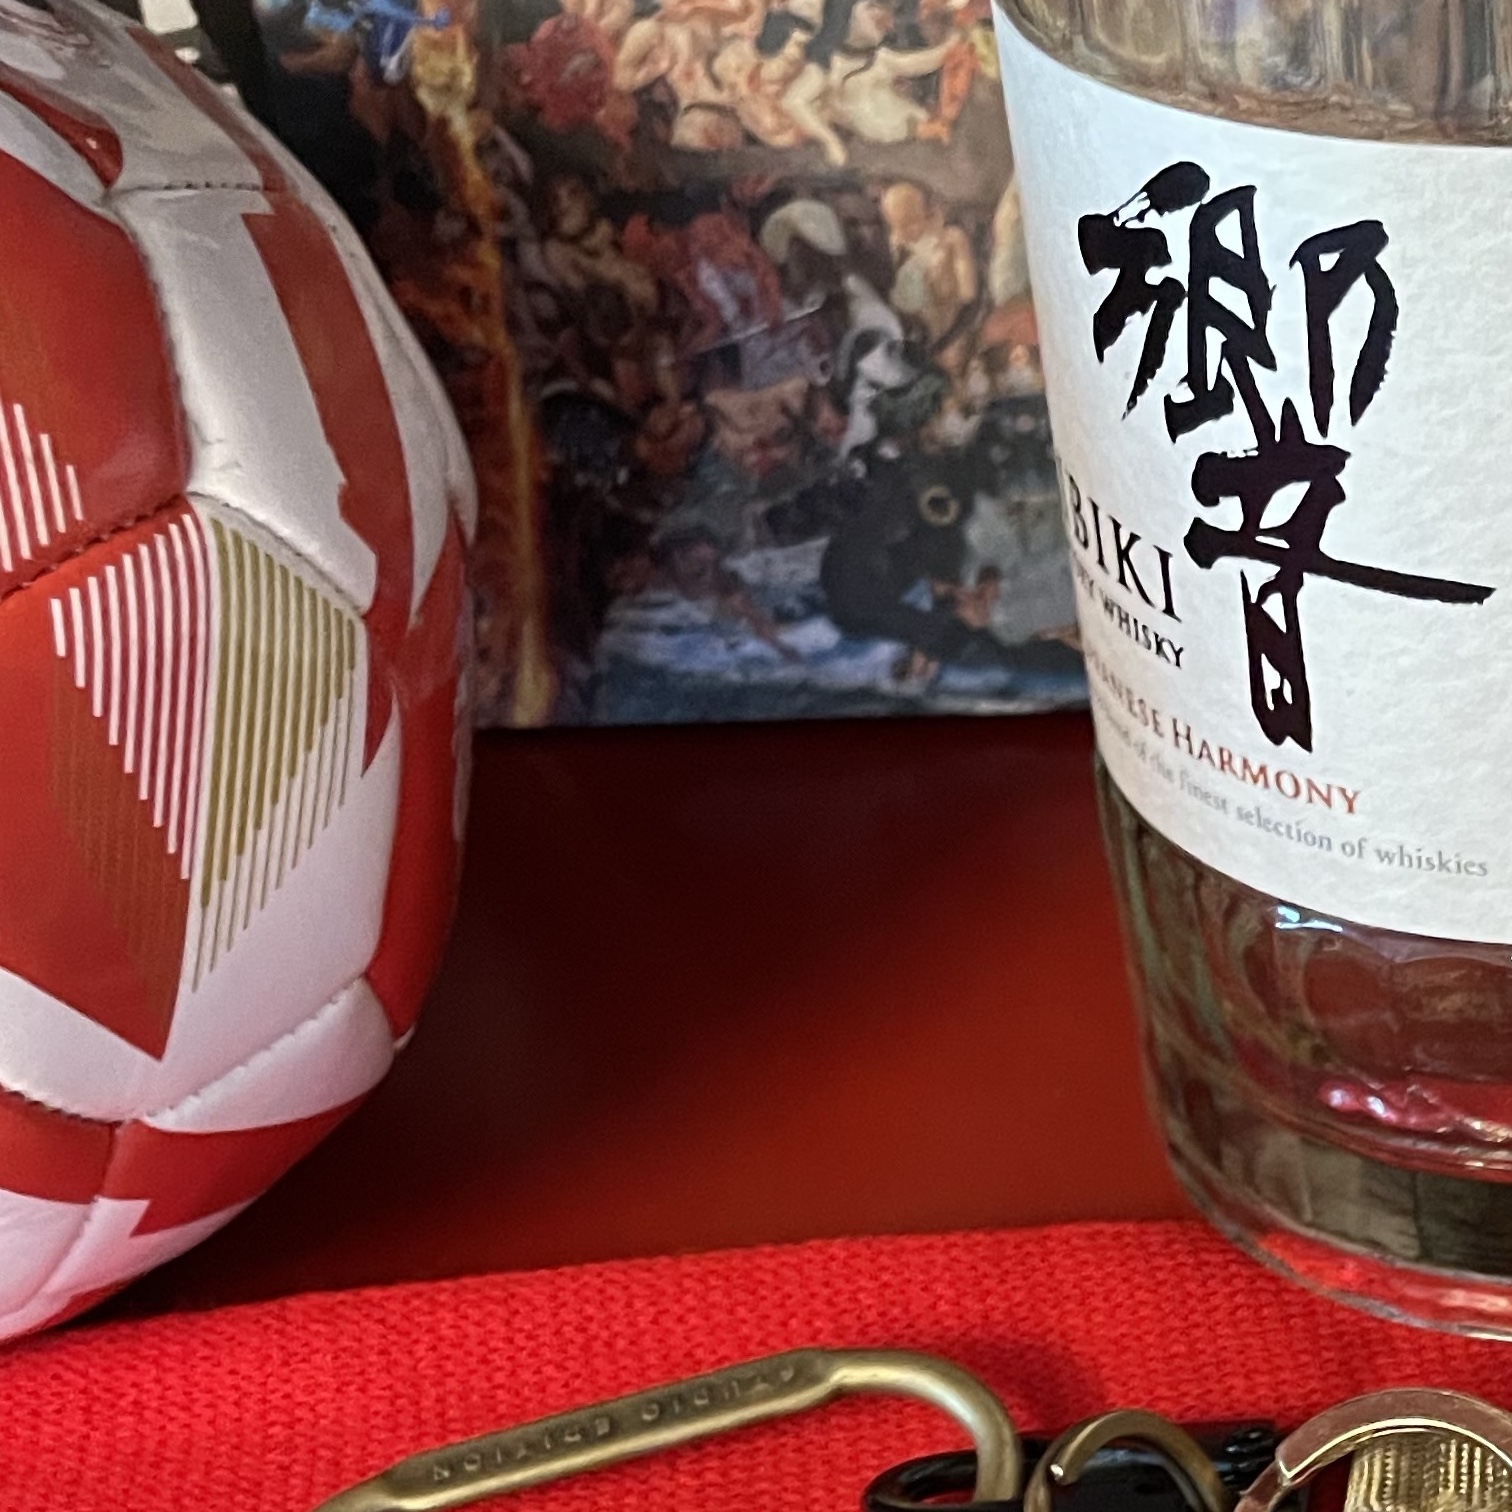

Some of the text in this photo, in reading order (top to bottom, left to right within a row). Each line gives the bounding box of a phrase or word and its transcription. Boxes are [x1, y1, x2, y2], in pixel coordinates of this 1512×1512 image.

[1101, 586, 1184, 670] WHISKY
[1172, 717, 1361, 816] HARMONY
[1178, 768, 1228, 816] finest
[1236, 806, 1333, 852] selection
[1341, 836, 1368, 860] of
[1374, 845, 1489, 879] whiskies
